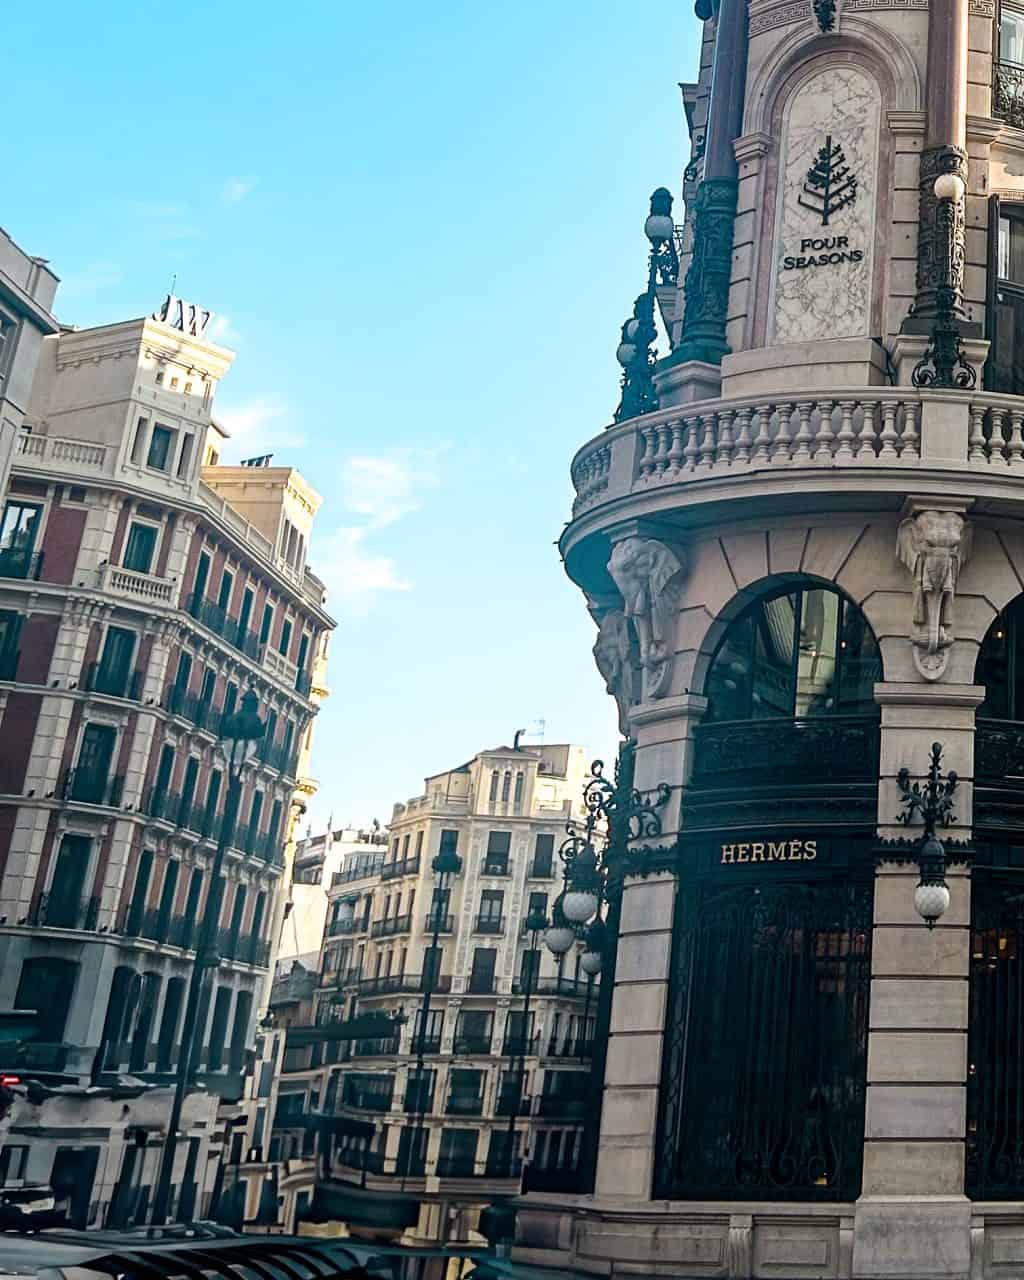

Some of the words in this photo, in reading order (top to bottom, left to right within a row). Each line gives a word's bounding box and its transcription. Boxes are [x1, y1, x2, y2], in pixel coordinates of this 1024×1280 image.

[800, 236, 849, 252] FOUR
[783, 250, 863, 270] SEASONS
[152, 294, 216, 337] JW
